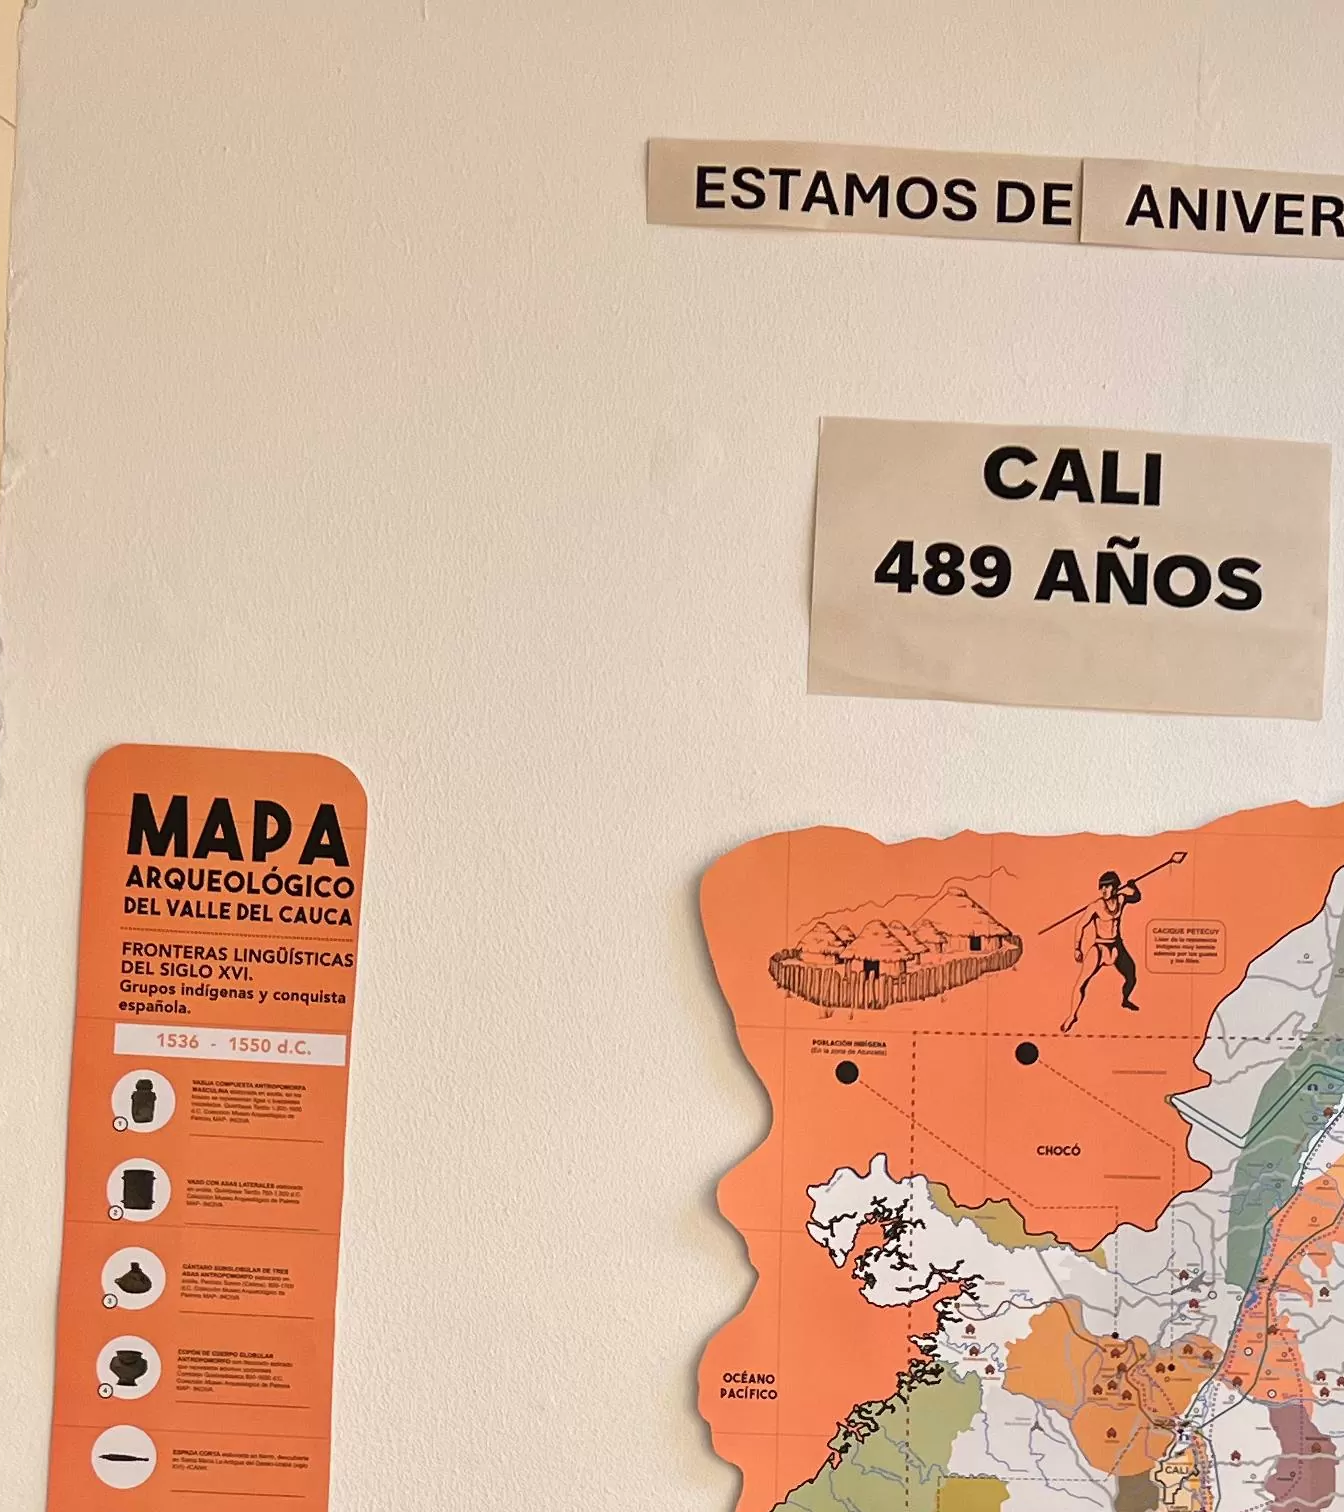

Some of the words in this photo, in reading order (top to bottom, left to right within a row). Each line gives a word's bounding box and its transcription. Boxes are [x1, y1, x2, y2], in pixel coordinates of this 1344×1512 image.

[696, 165, 977, 223] ESTAMOS
[996, 180, 1073, 226] DE
[984, 445, 1162, 507] CALI
[874, 539, 1013, 598] 489
[1034, 535, 1264, 612] AÑOS
[127, 792, 351, 867] MAPA
[125, 866, 355, 899] ARQUEOLÓGICO
[124, 897, 161, 917] DEL
[166, 899, 231, 921] VALLE
[236, 903, 274, 923] DEL
[279, 906, 353, 927] CAUCA
[122, 942, 228, 962] FRONTERAS
[233, 944, 355, 968] LINGÜÍSTICAS
[121, 960, 155, 977] DEL
[160, 961, 213, 980] SIGLO
[218, 965, 254, 982] XVI.
[120, 980, 177, 999] Grupos
[180, 981, 255, 1002] indígenas
[258, 989, 268, 1004] y
[272, 987, 347, 1006] conquista
[118, 999, 192, 1017] española.
[157, 1033, 200, 1050] 1536
[228, 1036, 272, 1054] 1550
[277, 1038, 312, 1056] d.C.
[1036, 1143, 1081, 1157] CHOCÓ
[722, 1369, 776, 1385] OCÉANO
[720, 1385, 778, 1401] PACÍFICO
[1165, 1465, 1189, 1475] CALI
